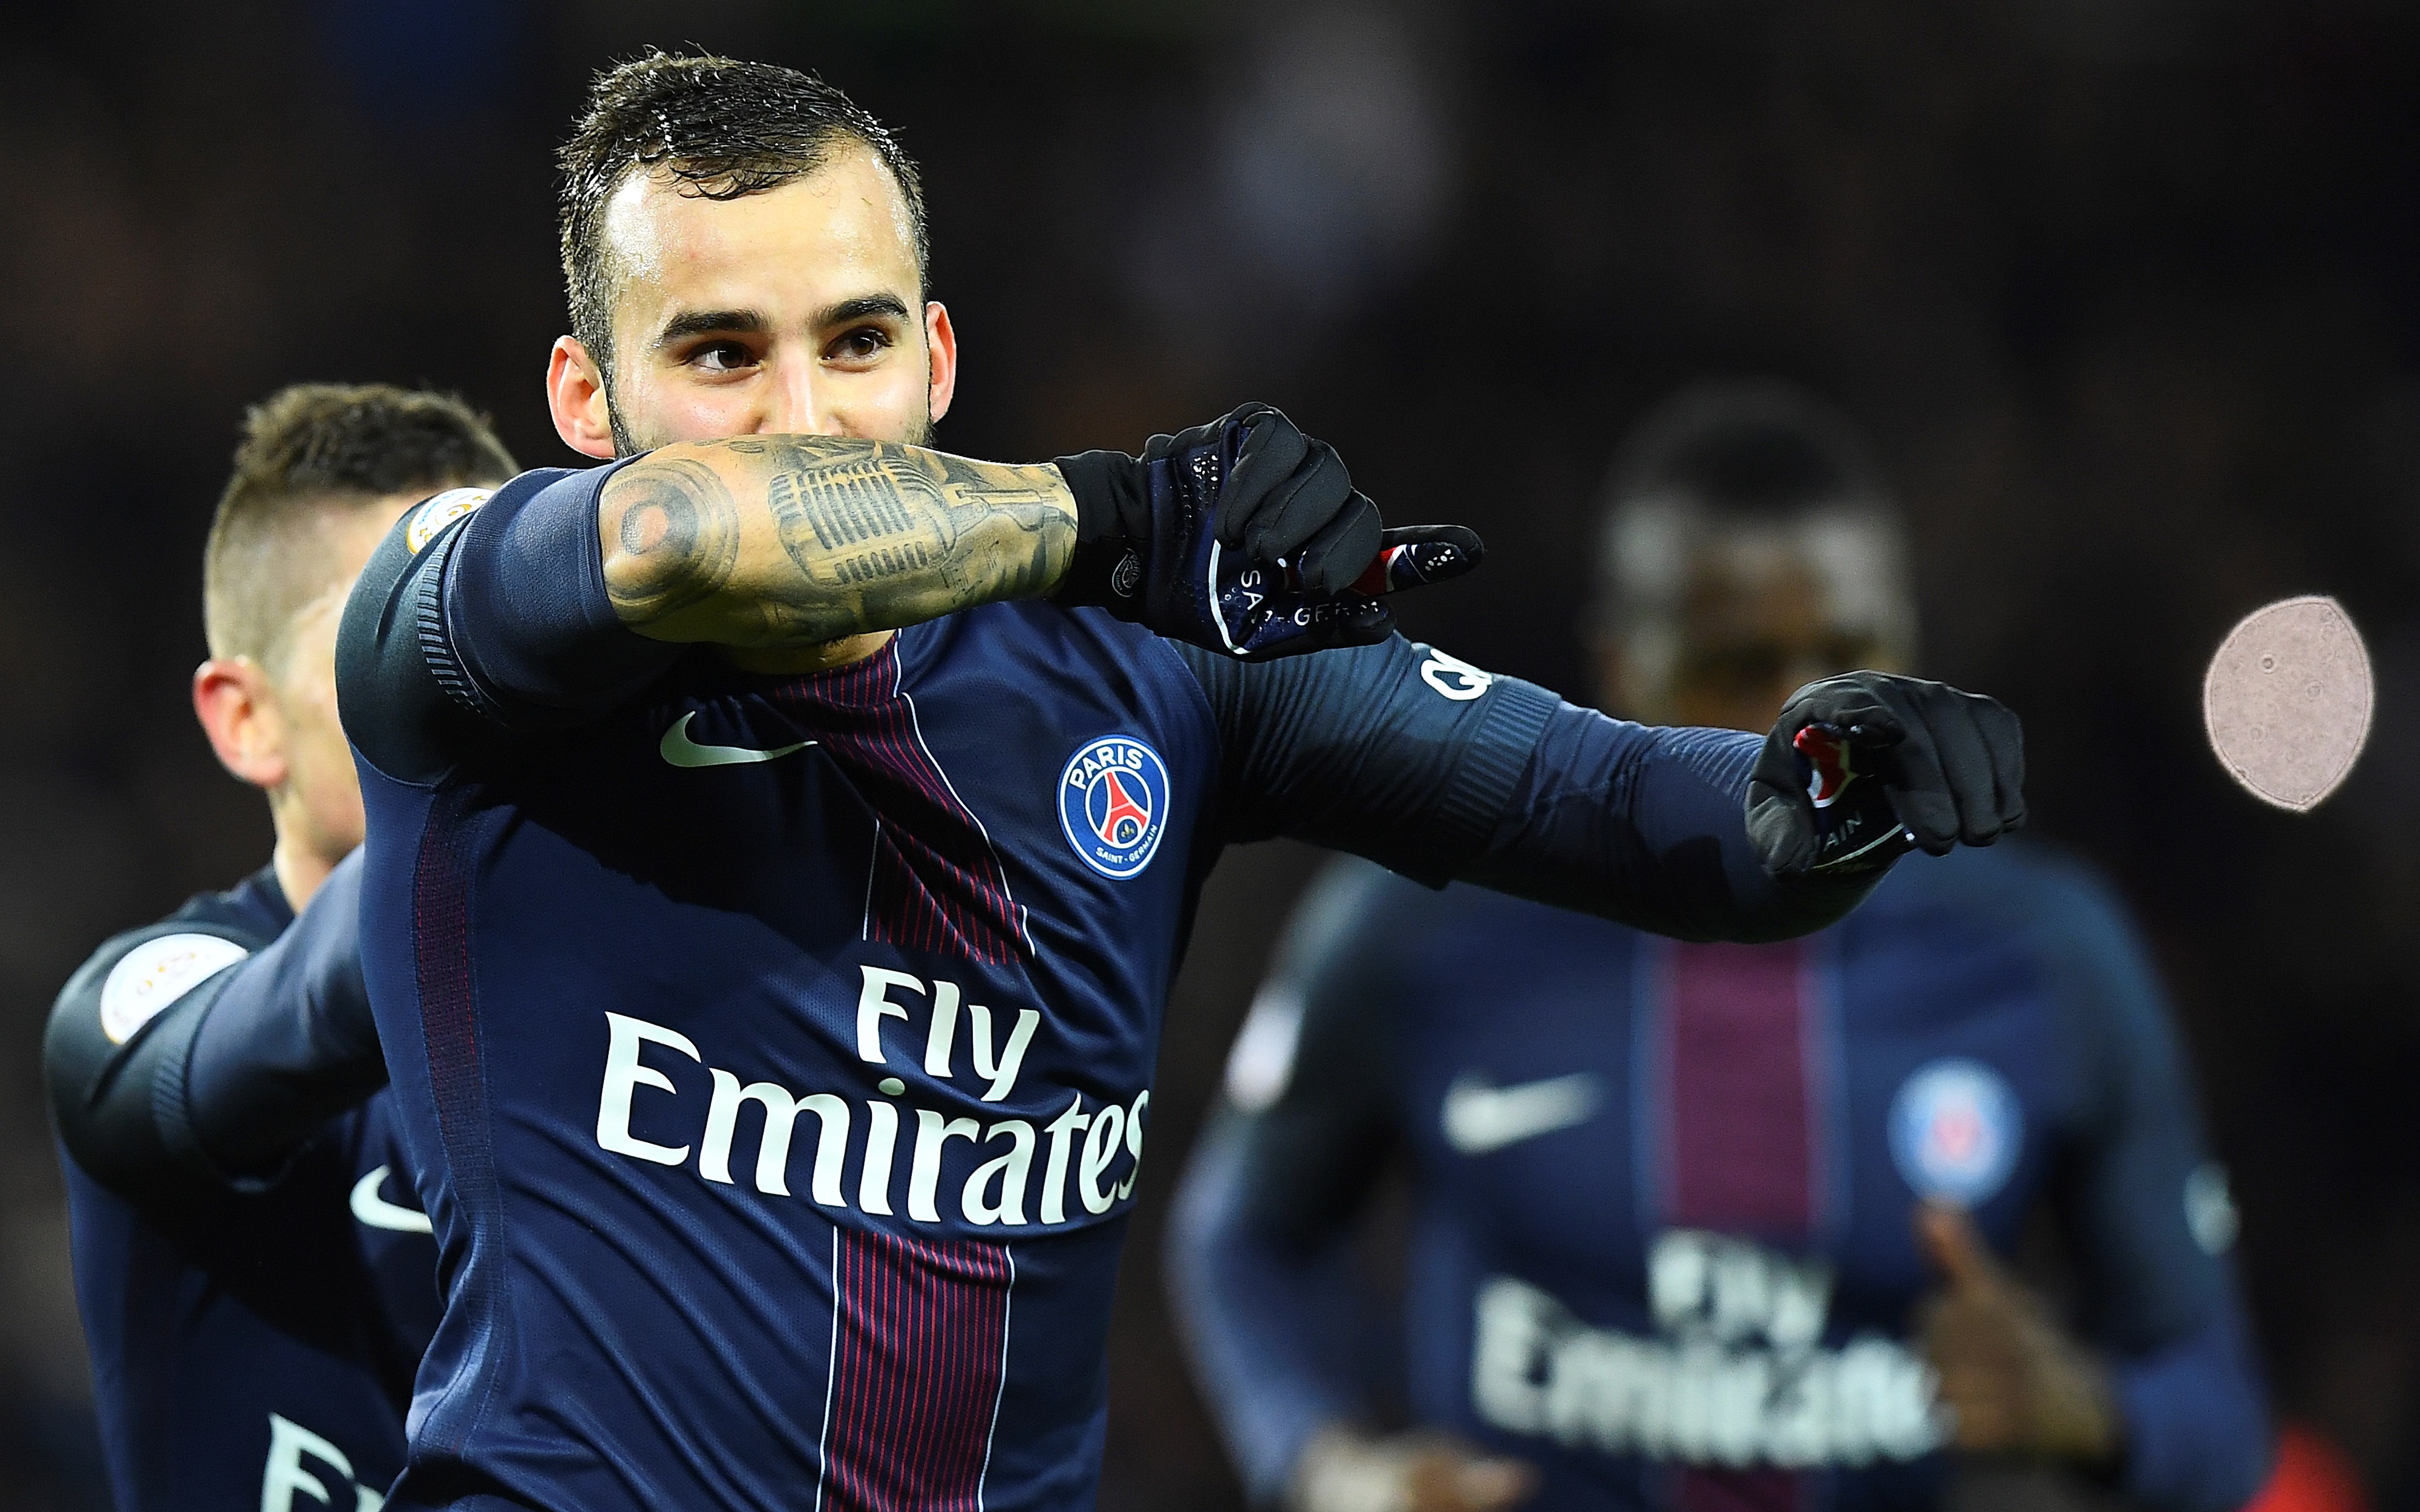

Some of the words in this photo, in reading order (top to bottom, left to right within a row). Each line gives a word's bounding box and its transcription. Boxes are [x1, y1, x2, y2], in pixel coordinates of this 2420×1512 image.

[1069, 745, 1143, 790] PARIS
[857, 966, 1040, 1101] Fly
[597, 1012, 1150, 1225] Emirates
